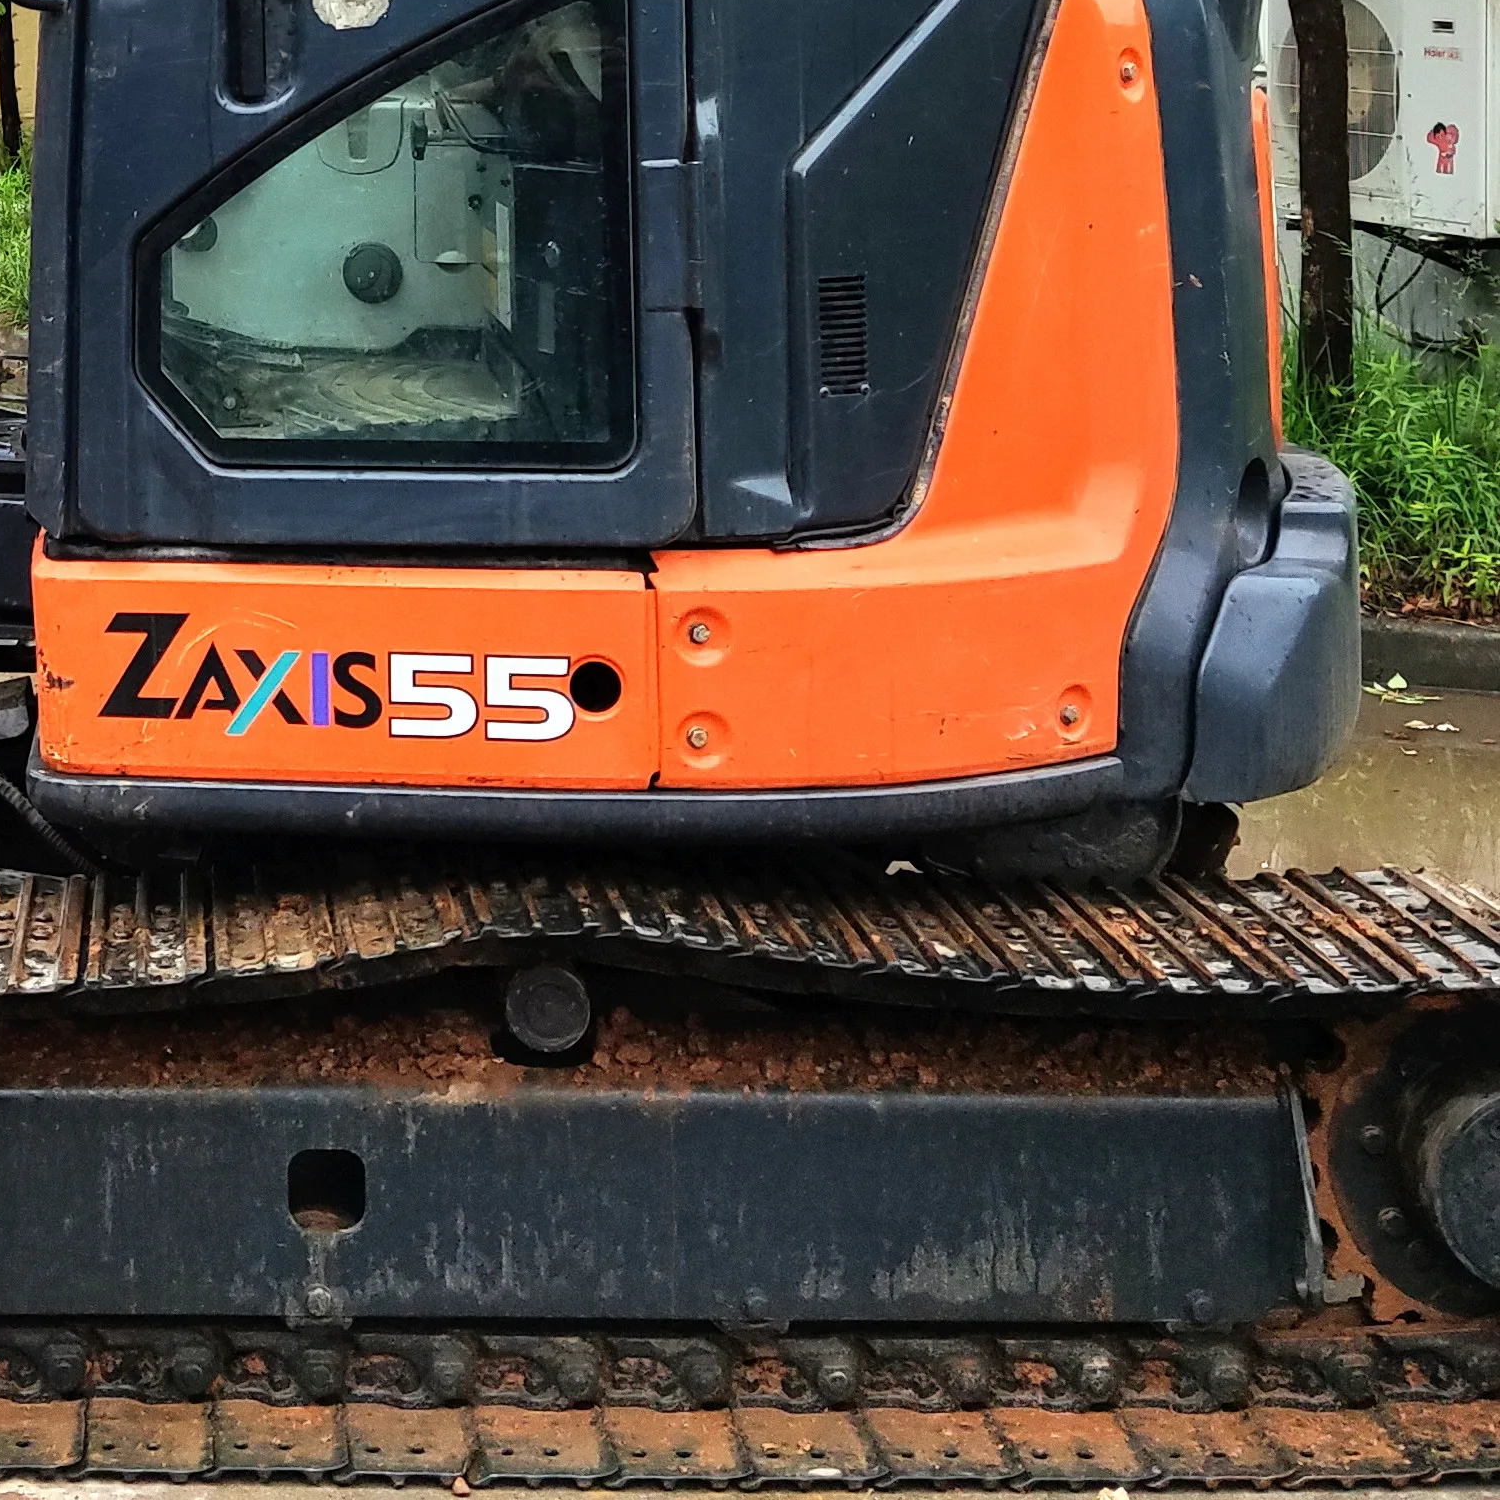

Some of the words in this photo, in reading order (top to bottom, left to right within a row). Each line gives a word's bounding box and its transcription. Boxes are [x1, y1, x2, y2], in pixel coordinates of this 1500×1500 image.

[1423, 47, 1446, 58] Haier
[97, 612, 383, 737] ZAXIS
[388, 651, 577, 743] 55
